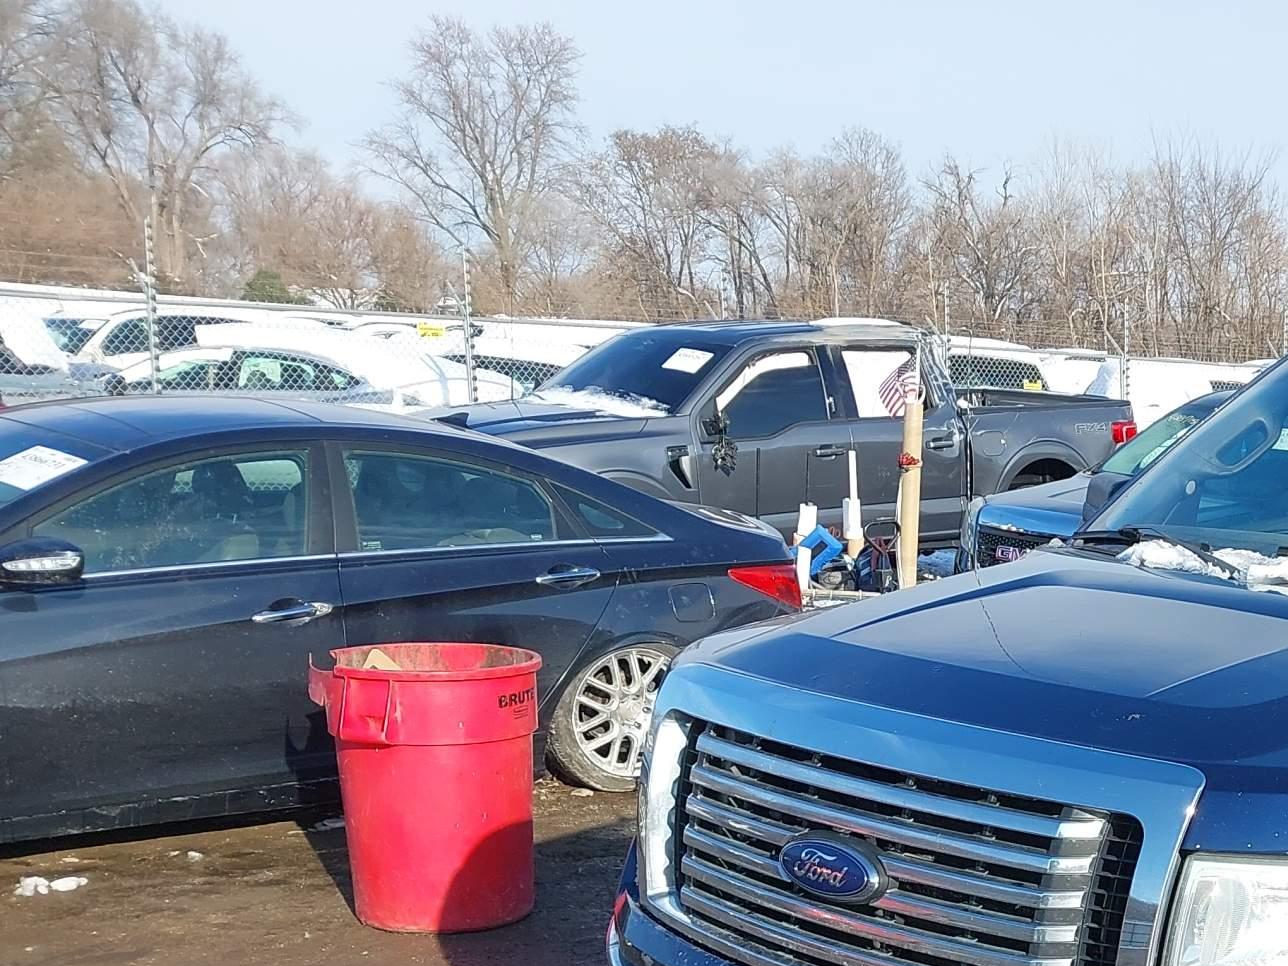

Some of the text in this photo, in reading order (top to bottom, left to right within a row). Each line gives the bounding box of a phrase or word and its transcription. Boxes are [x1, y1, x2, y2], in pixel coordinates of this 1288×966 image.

[1074, 422, 1107, 435] FX4
[996, 545, 1027, 562] GM
[793, 848, 849, 888] Ford
